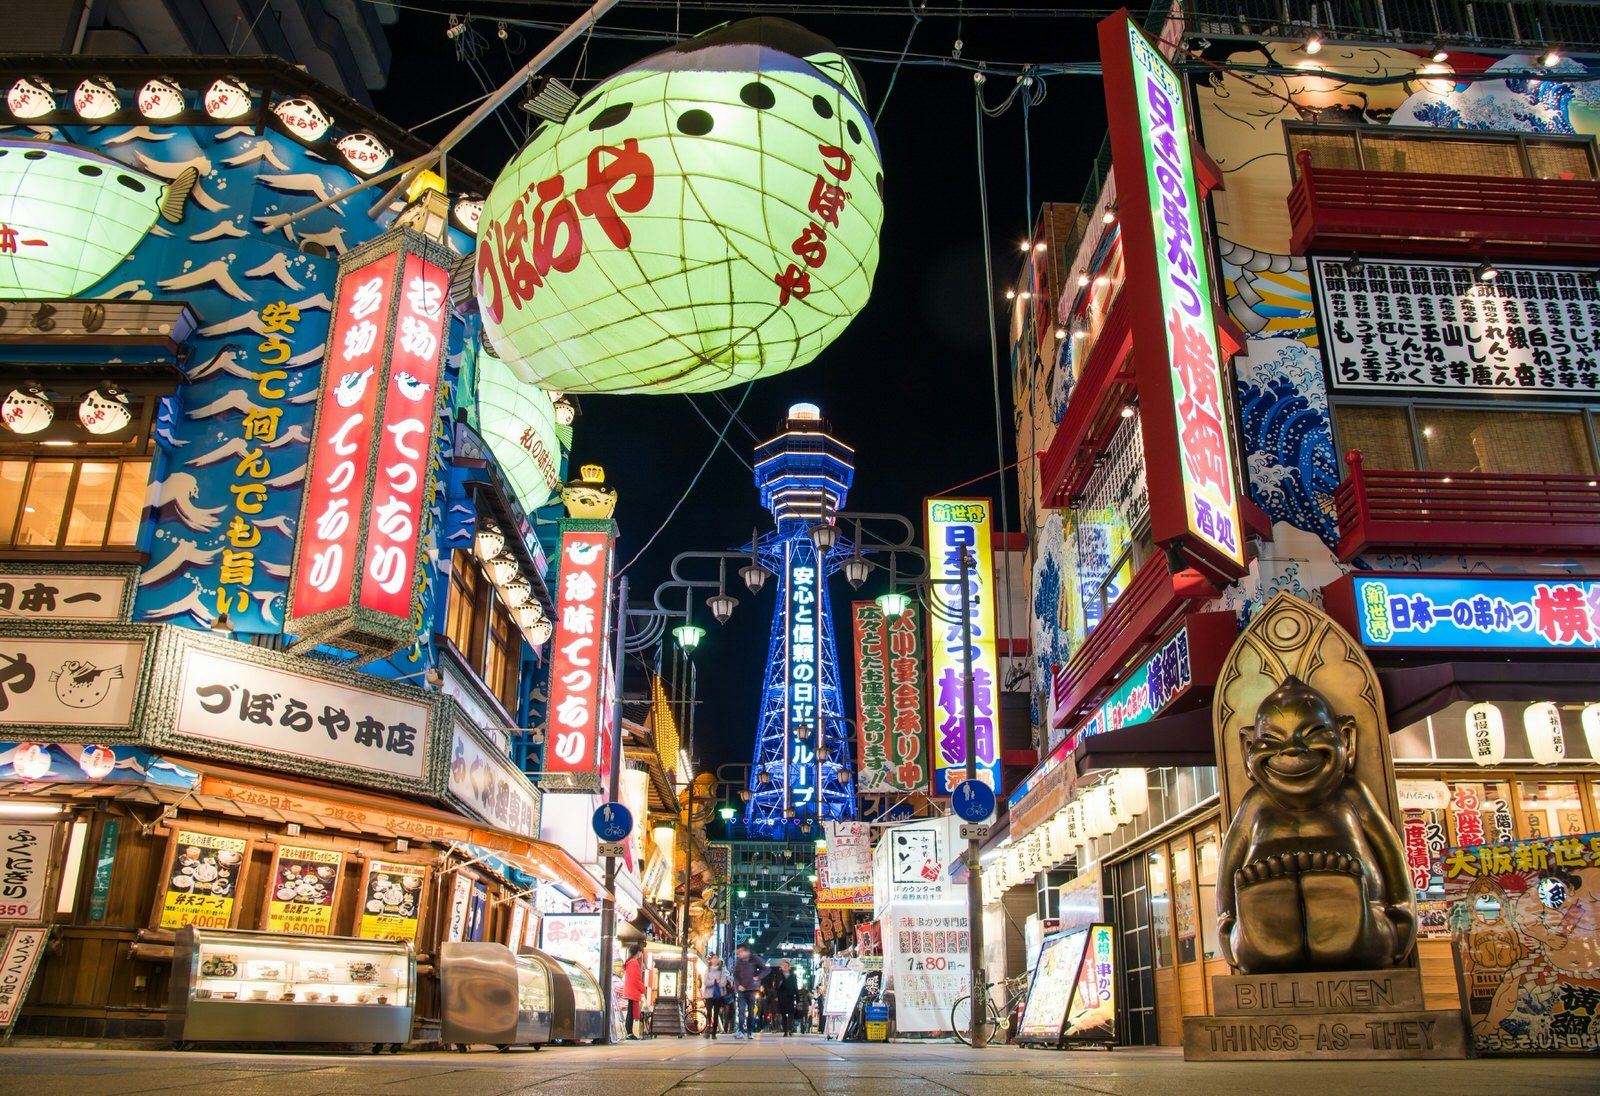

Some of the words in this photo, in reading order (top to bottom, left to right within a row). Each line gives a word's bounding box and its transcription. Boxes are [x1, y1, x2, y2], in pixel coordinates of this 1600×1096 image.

[478, 137, 655, 326] づぼらや
[774, 143, 854, 307] づぼらや
[1323, 263, 1347, 292] 前頭
[1344, 264, 1369, 293] 頭
[1366, 265, 1390, 294] 前頭
[1388, 266, 1412, 295] 前頭
[1409, 266, 1433, 296] 前頭
[1430, 267, 1455, 297] 前頭
[1451, 268, 1476, 298] 前頭
[1474, 270, 1497, 298] 頭
[1495, 270, 1518, 299] 前頭
[1556, 272, 1581, 301] 前頭
[1577, 273, 1600, 301] 前頭
[343, 276, 385, 362] 名物
[1514, 271, 1539, 300] 前頭
[1528, 327, 1557, 388] 白ねぎ
[1535, 271, 1560, 300] 前頭
[1550, 327, 1579, 388] さつま芋
[1333, 319, 1360, 381] もち
[1356, 320, 1385, 382] うずら玉子
[1398, 322, 1425, 384] にんにく
[1420, 323, 1449, 384] 玉ねぎ
[1441, 323, 1471, 386] 山芋
[1463, 324, 1493, 386] しし唐
[1485, 325, 1516, 387] れんこん
[1505, 326, 1536, 387] 銀杏
[214, 300, 300, 614] 安うて何んでも旨い
[308, 413, 364, 594] てっちり
[369, 418, 426, 595] てっちり
[932, 504, 986, 523] 新世界
[1193, 491, 1236, 554] 酒処
[1364, 583, 1391, 640] 新世界
[1390, 595, 1533, 630] 日本一の串かつ
[1534, 586, 1600, 643] 横
[196, 682, 418, 757] づぼらや本店
[938, 668, 994, 764] 横綱
[1473, 711, 1492, 756] 自慢の逸品
[962, 828, 988, 837] 9-22
[1427, 809, 1445, 852] ースの
[1566, 813, 1580, 836] にん
[175, 893, 226, 909] 弁天コース
[1096, 930, 1112, 1001] 本場の串かつ
[1235, 978, 1395, 1010] BILLIKEN
[1205, 1020, 1436, 1052] THINGS-AS-THEY
